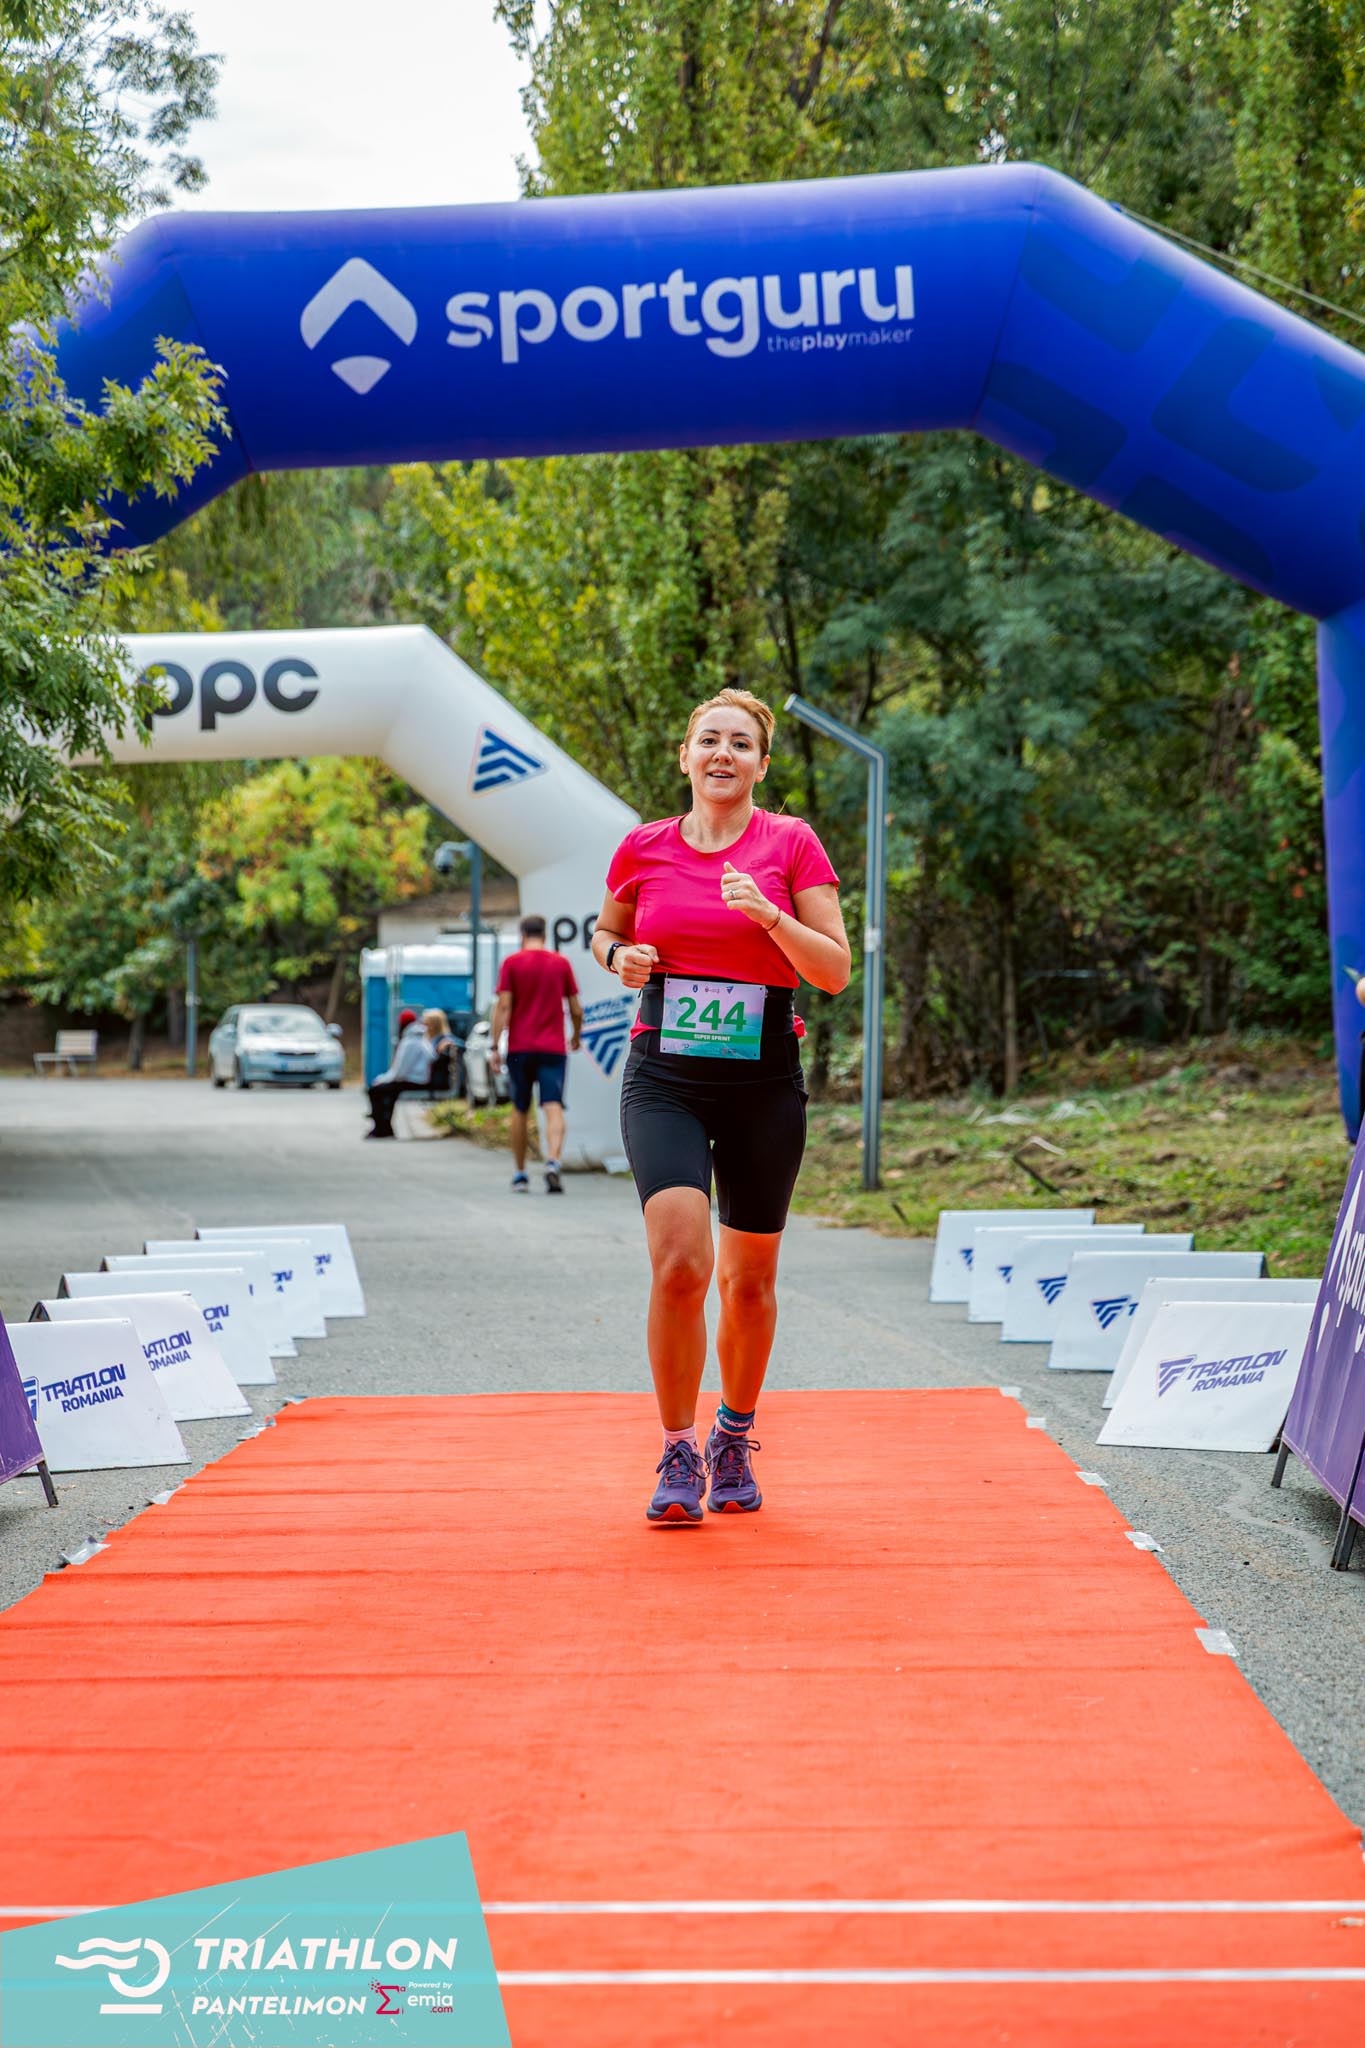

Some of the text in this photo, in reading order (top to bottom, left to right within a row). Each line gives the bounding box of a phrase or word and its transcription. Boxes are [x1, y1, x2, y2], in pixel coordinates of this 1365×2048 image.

[446, 265, 915, 364] sportguru
[677, 997, 746, 1032] 244
[149, 1350, 192, 1372] OMANIA
[1192, 1370, 1264, 1392] ROMANIA
[61, 1386, 124, 1413] ROMANIA
